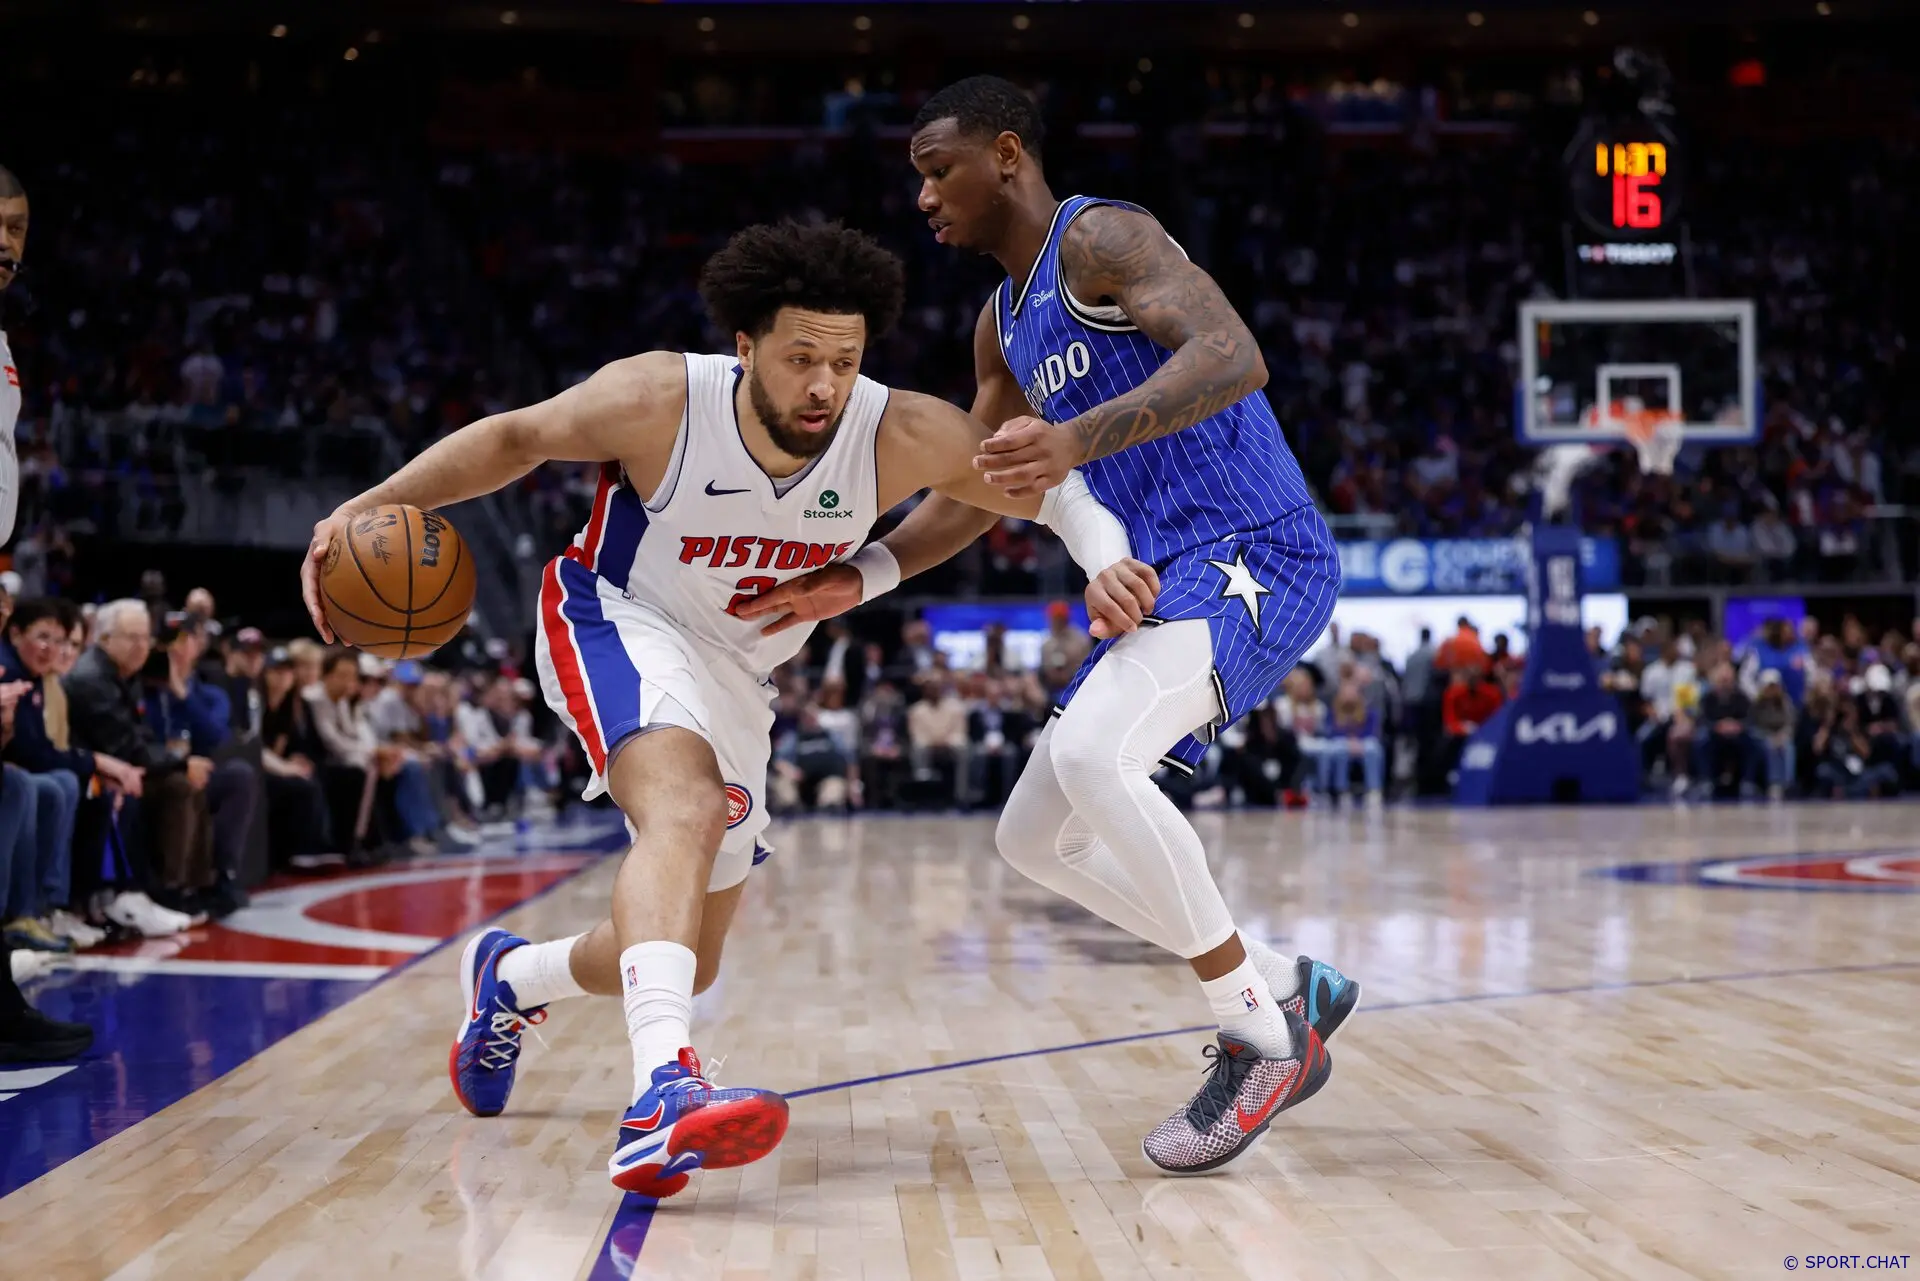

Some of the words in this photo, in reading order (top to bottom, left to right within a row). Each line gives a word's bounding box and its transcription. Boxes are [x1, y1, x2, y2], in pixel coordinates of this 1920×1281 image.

[1613, 171, 1661, 228] 16
[803, 509, 853, 519] StockX
[724, 575, 778, 616] 2
